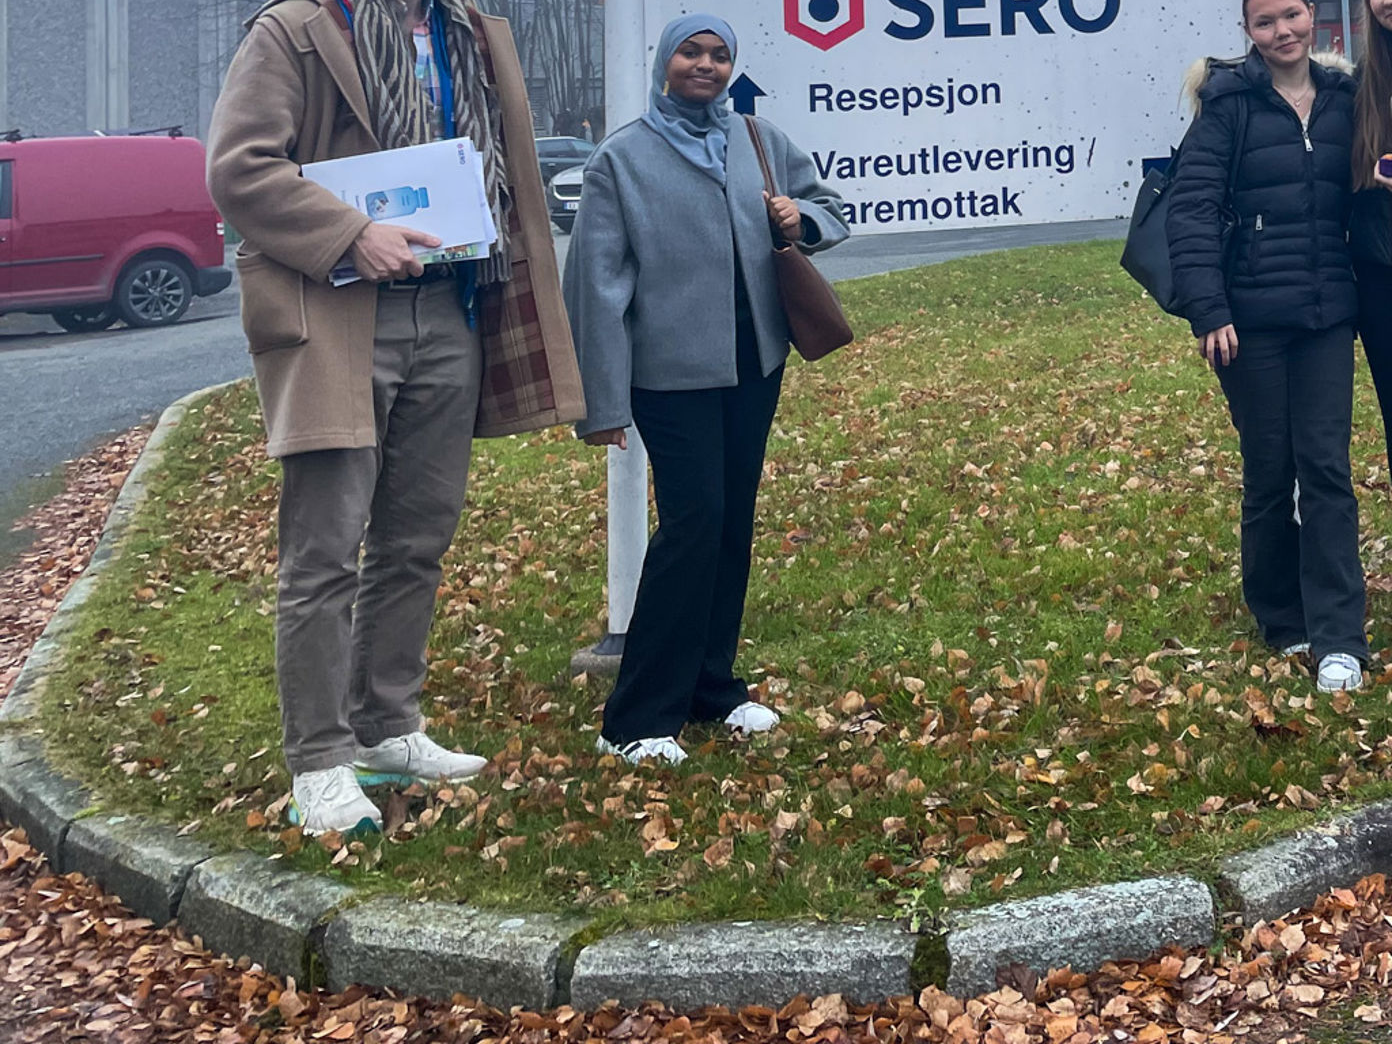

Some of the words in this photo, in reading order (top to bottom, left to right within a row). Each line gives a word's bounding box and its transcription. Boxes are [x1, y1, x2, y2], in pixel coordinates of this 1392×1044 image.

[809, 77, 1001, 117] Resepsjon
[811, 140, 1075, 180] Vareutlevering
[1086, 136, 1097, 167] /
[840, 186, 1023, 225] aremottak
